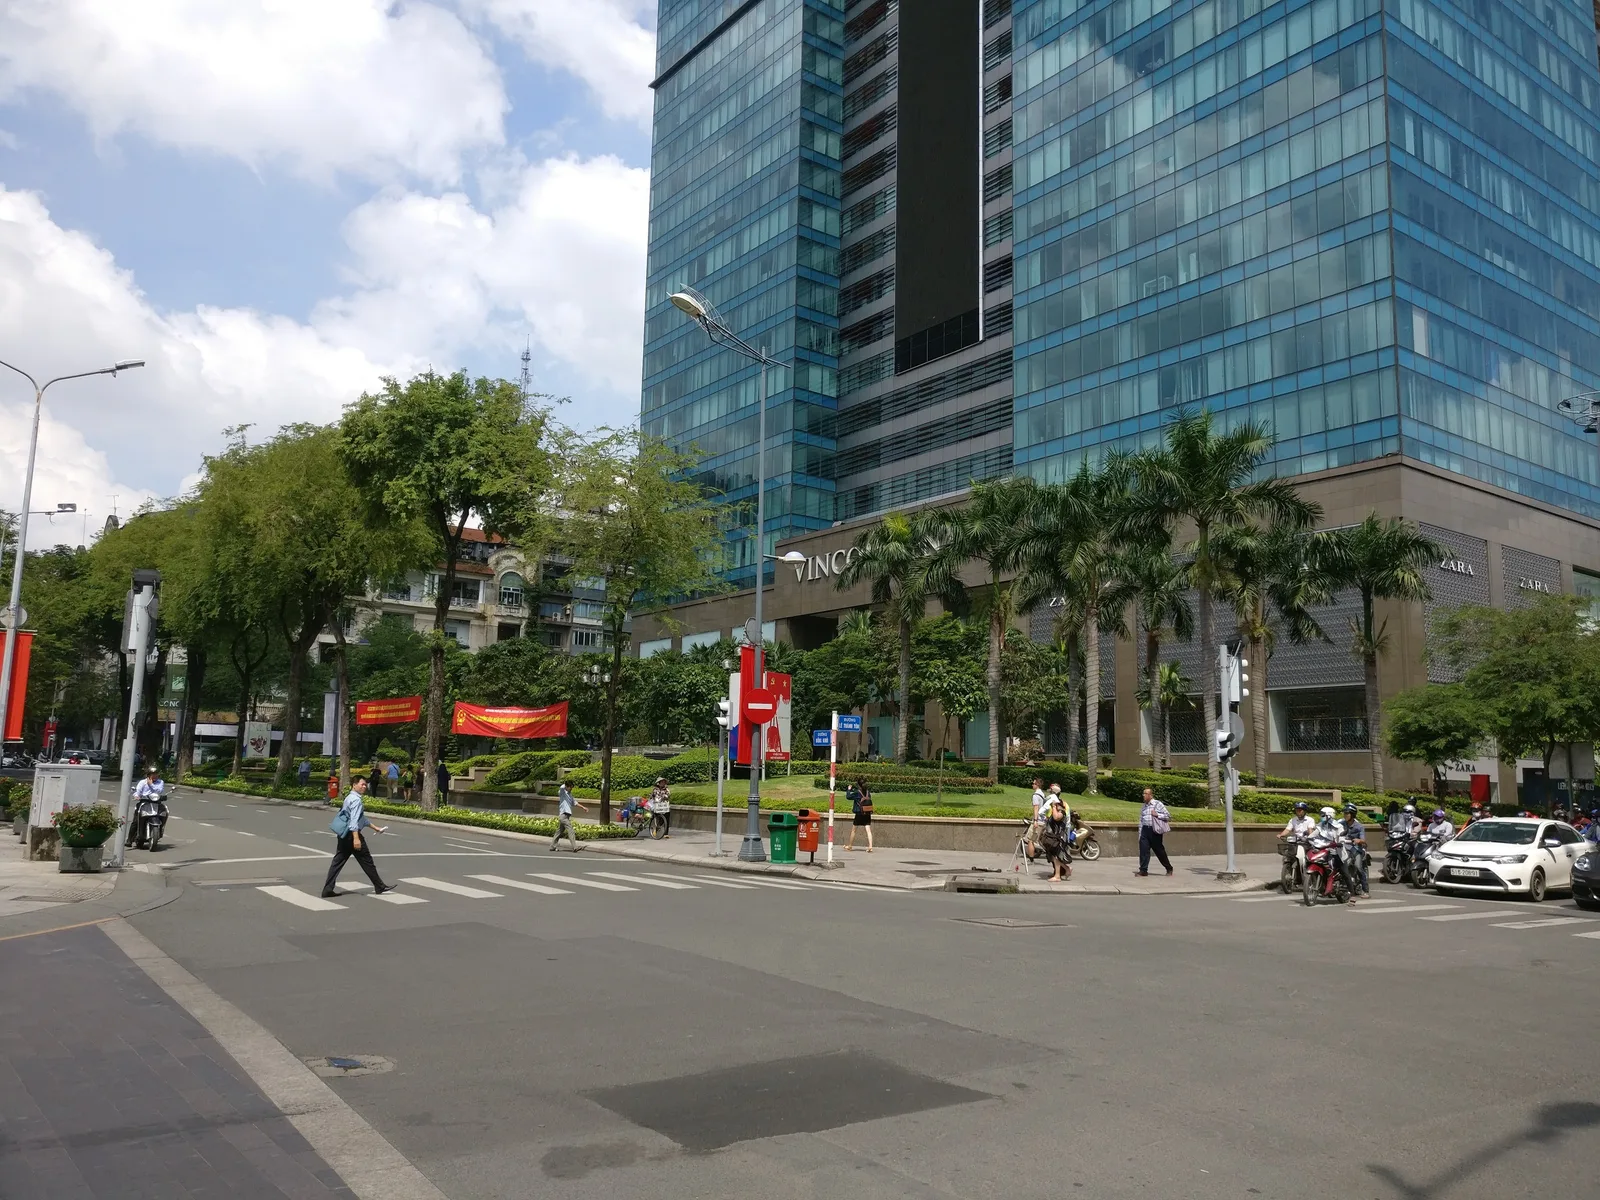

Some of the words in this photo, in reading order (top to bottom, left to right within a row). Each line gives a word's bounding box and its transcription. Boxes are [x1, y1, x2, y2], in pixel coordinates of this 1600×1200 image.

[793, 547, 864, 582] VINCO
[1440, 558, 1474, 576] ZARA
[1520, 577, 1549, 593] ZARA
[1454, 763, 1476, 773] ZARA
